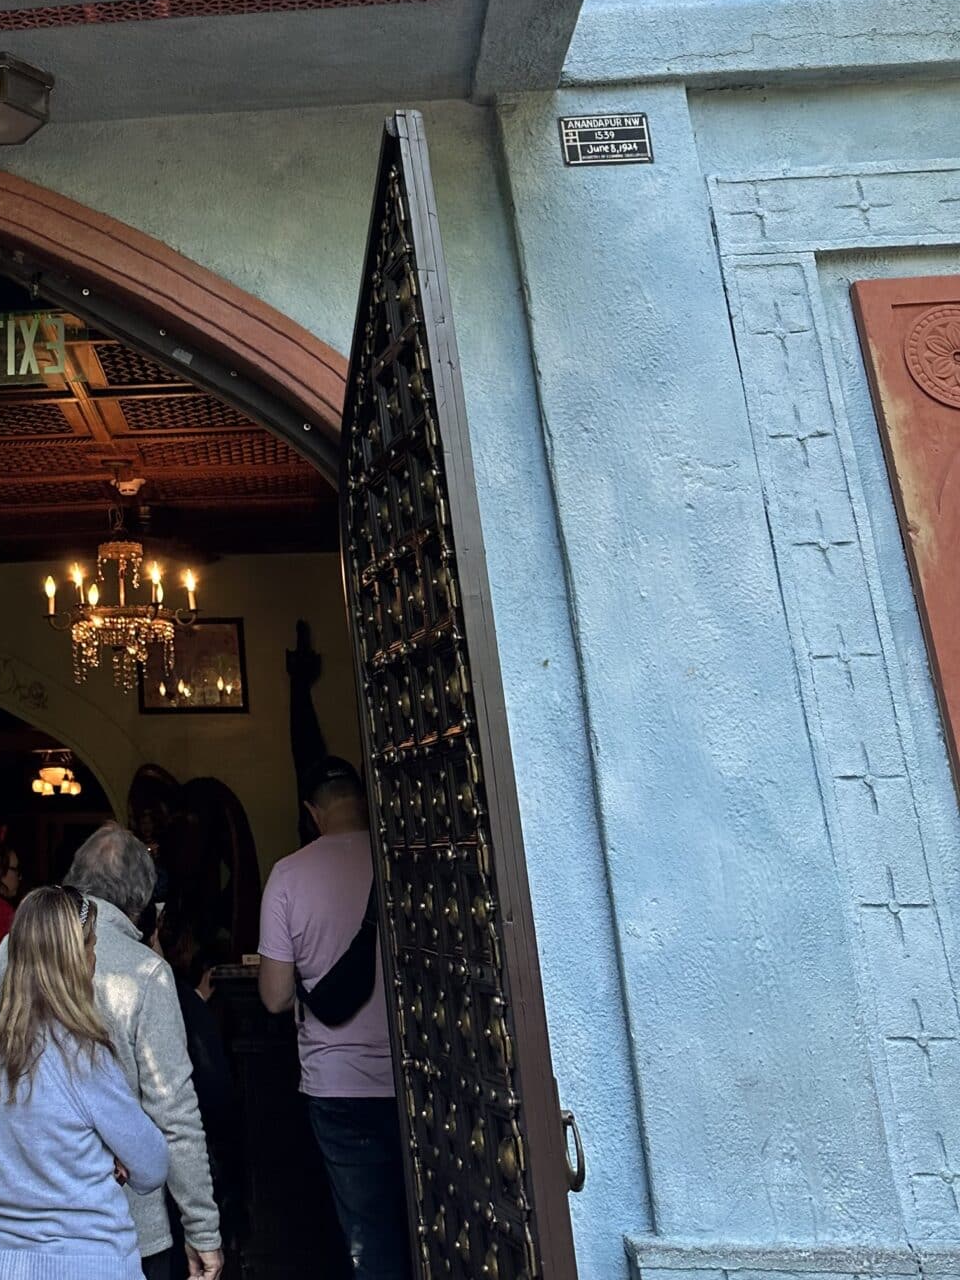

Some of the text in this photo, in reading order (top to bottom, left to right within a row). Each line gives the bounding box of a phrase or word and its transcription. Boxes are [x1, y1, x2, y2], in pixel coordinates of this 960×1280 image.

[567, 117, 640, 129] ANANDAPUR NW
[587, 144, 609, 154] June
